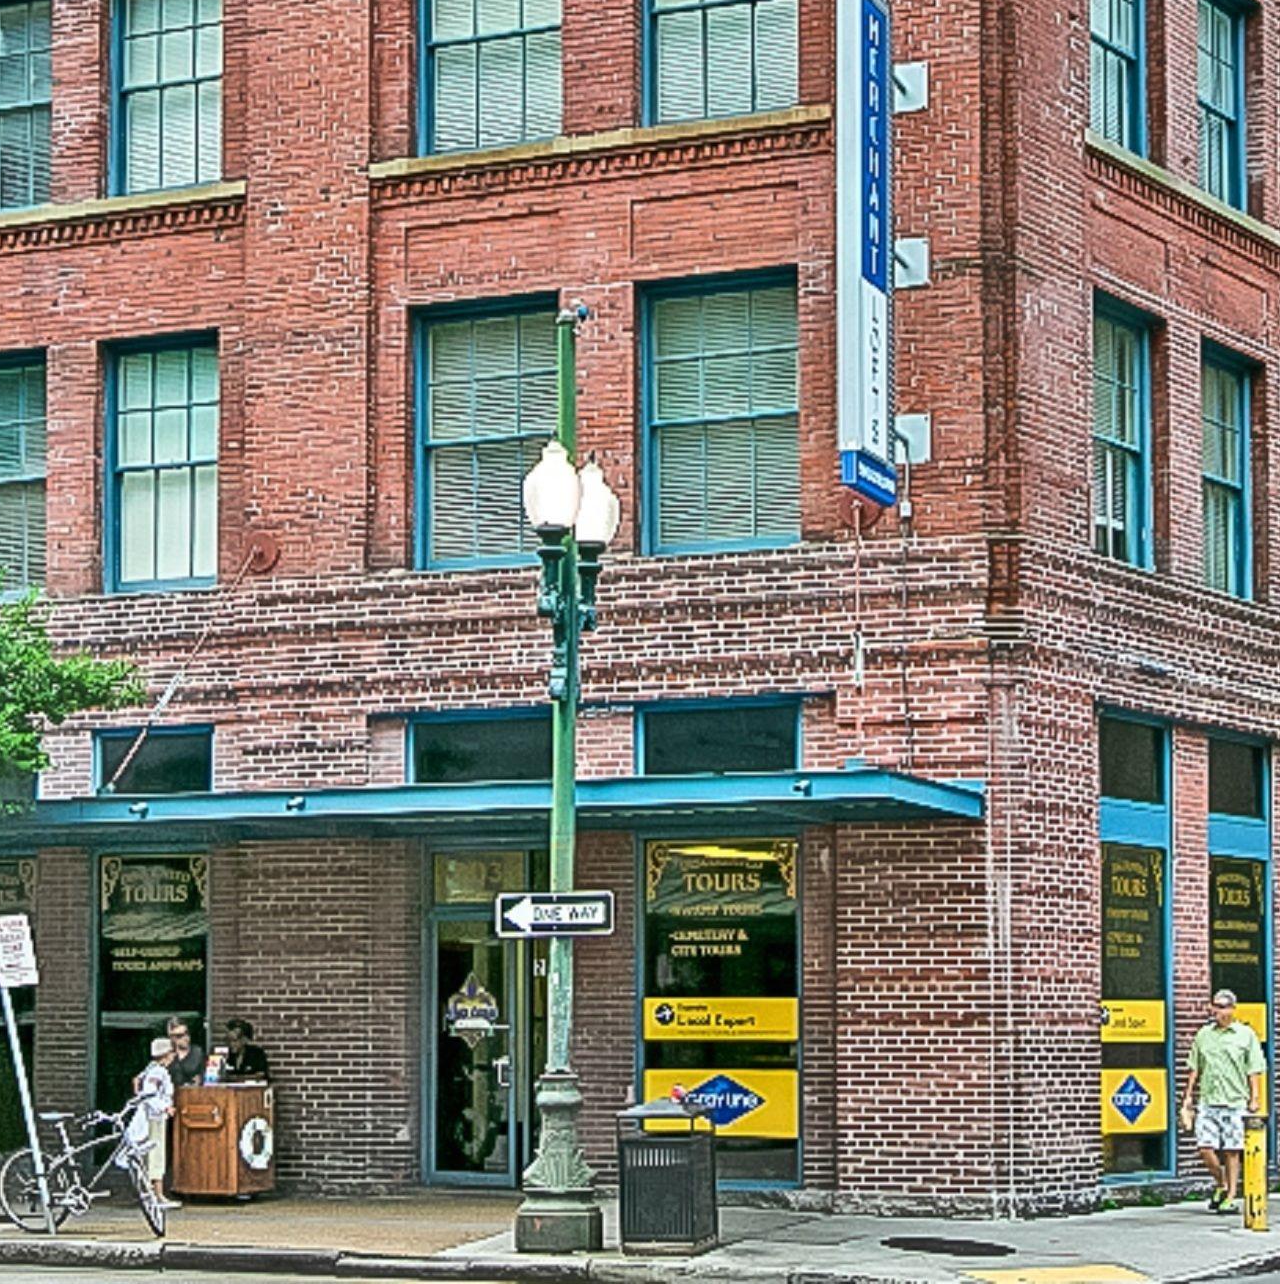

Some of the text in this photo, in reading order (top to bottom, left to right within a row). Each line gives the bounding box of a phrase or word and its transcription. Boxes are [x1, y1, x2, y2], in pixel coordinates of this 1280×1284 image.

[682, 872, 761, 892] TOURS
[120, 884, 188, 904] TOURS
[533, 905, 599, 922] ONE WAY
